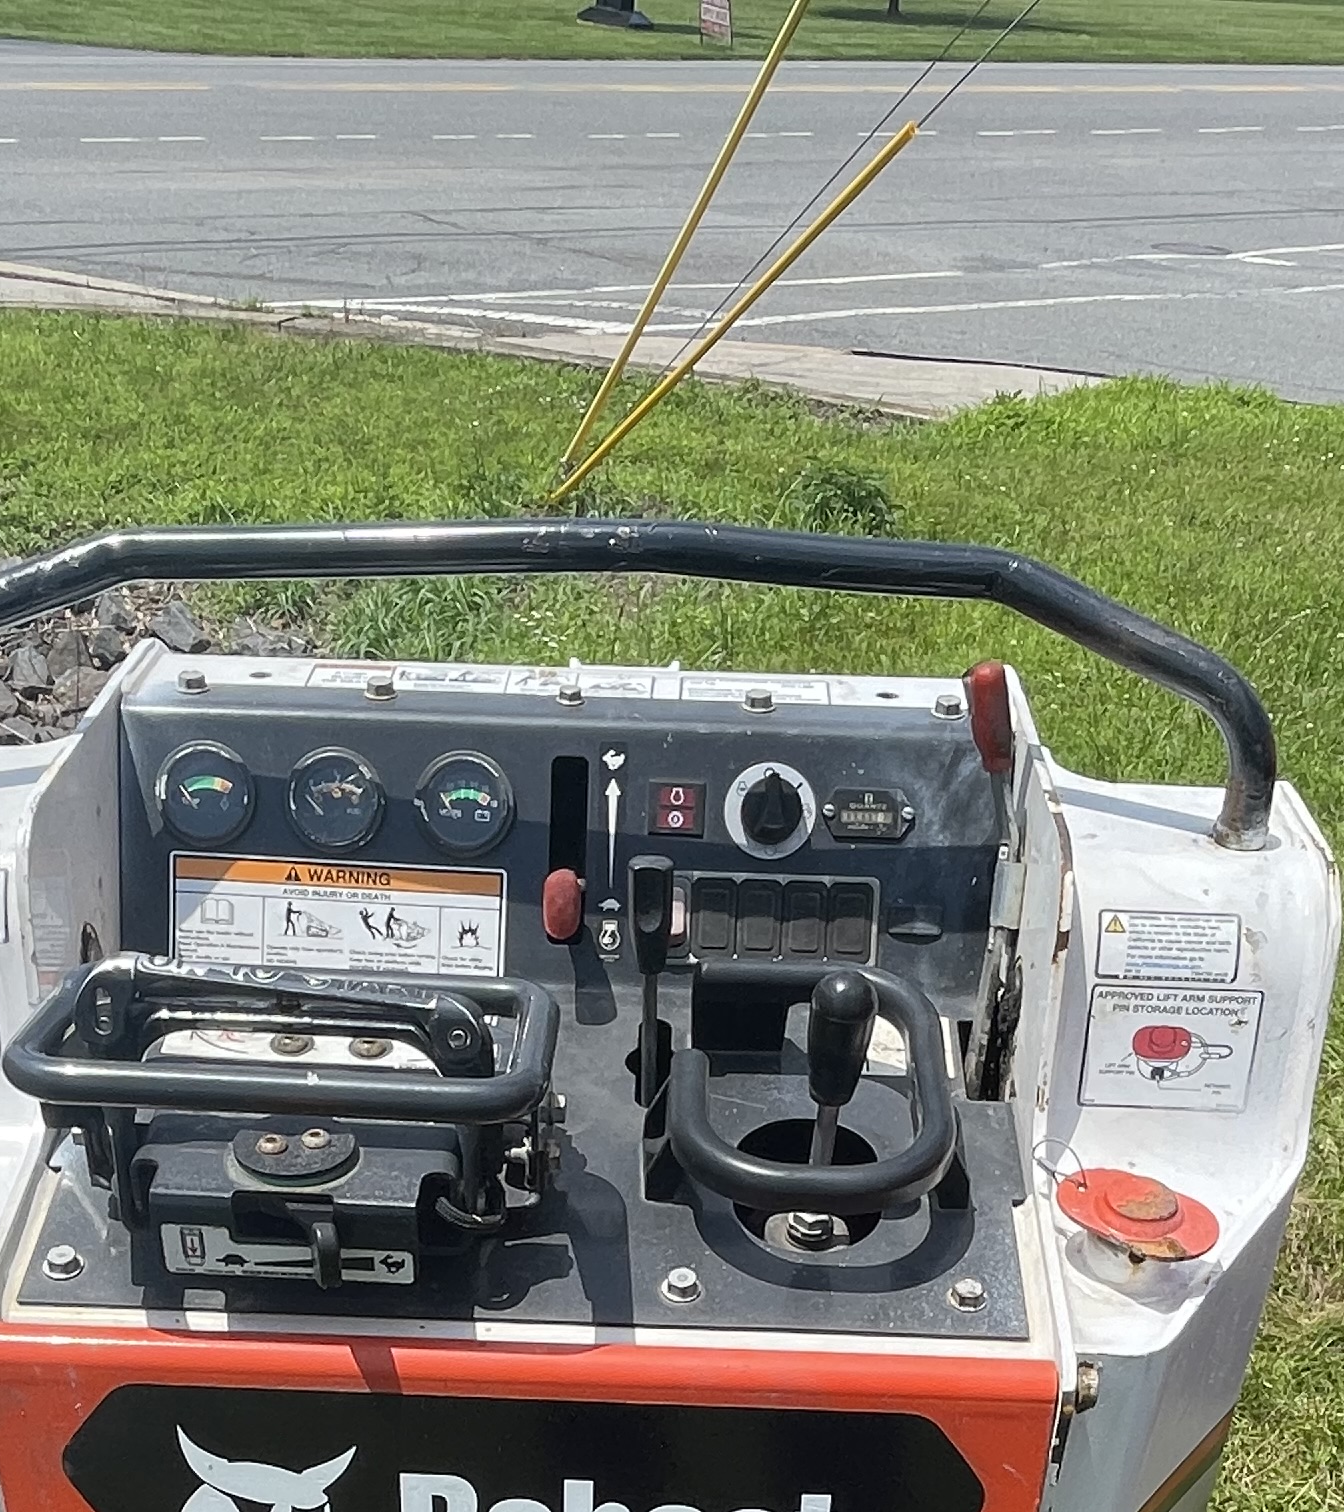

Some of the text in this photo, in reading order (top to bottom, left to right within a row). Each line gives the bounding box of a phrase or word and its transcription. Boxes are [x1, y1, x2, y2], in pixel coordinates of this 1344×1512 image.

[308, 868, 391, 886] WARNING
[282, 888, 309, 897] AVOID
[312, 890, 344, 898] INJURY
[361, 893, 391, 901] DEATH
[1097, 990, 1257, 1005] APPROVED LIFT ARM SUPPORT
[1113, 1003, 1239, 1017] PIN STORAGE LOCATION
